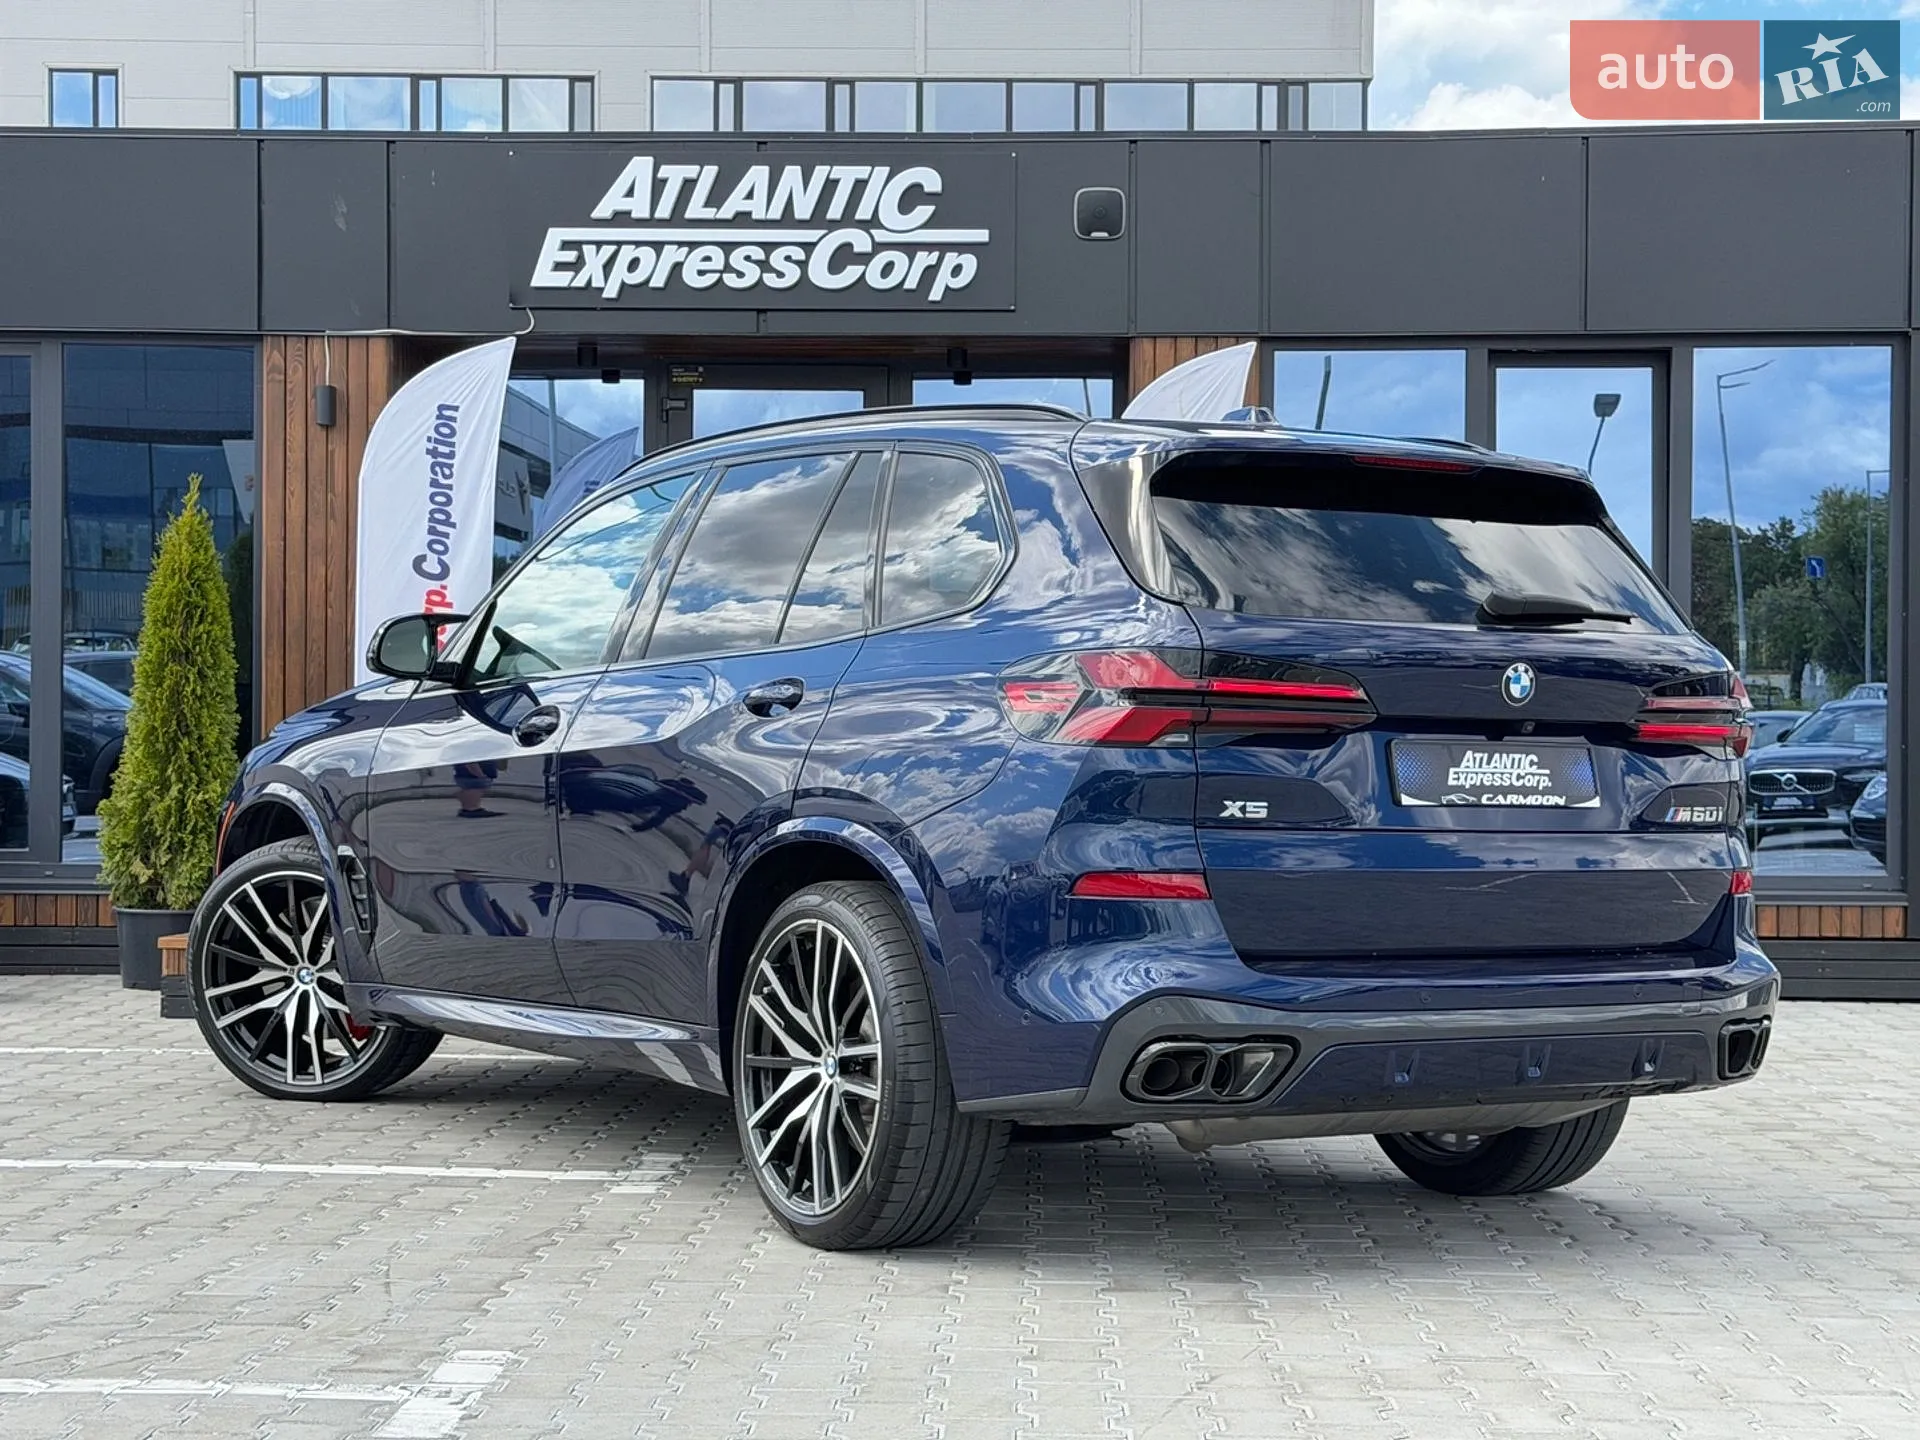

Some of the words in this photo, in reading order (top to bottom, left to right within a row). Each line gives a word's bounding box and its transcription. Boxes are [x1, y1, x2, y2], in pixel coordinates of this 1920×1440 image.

[590, 156, 942, 231] ATLANTIC
[530, 227, 978, 301] ExpressCorp
[412, 403, 461, 582] Corporation
[1460, 750, 1538, 771] ATLANTIC
[1447, 768, 1552, 790] ExpressCorp.
[1220, 800, 1268, 818] X5
[1481, 793, 1567, 806] CARMOON
